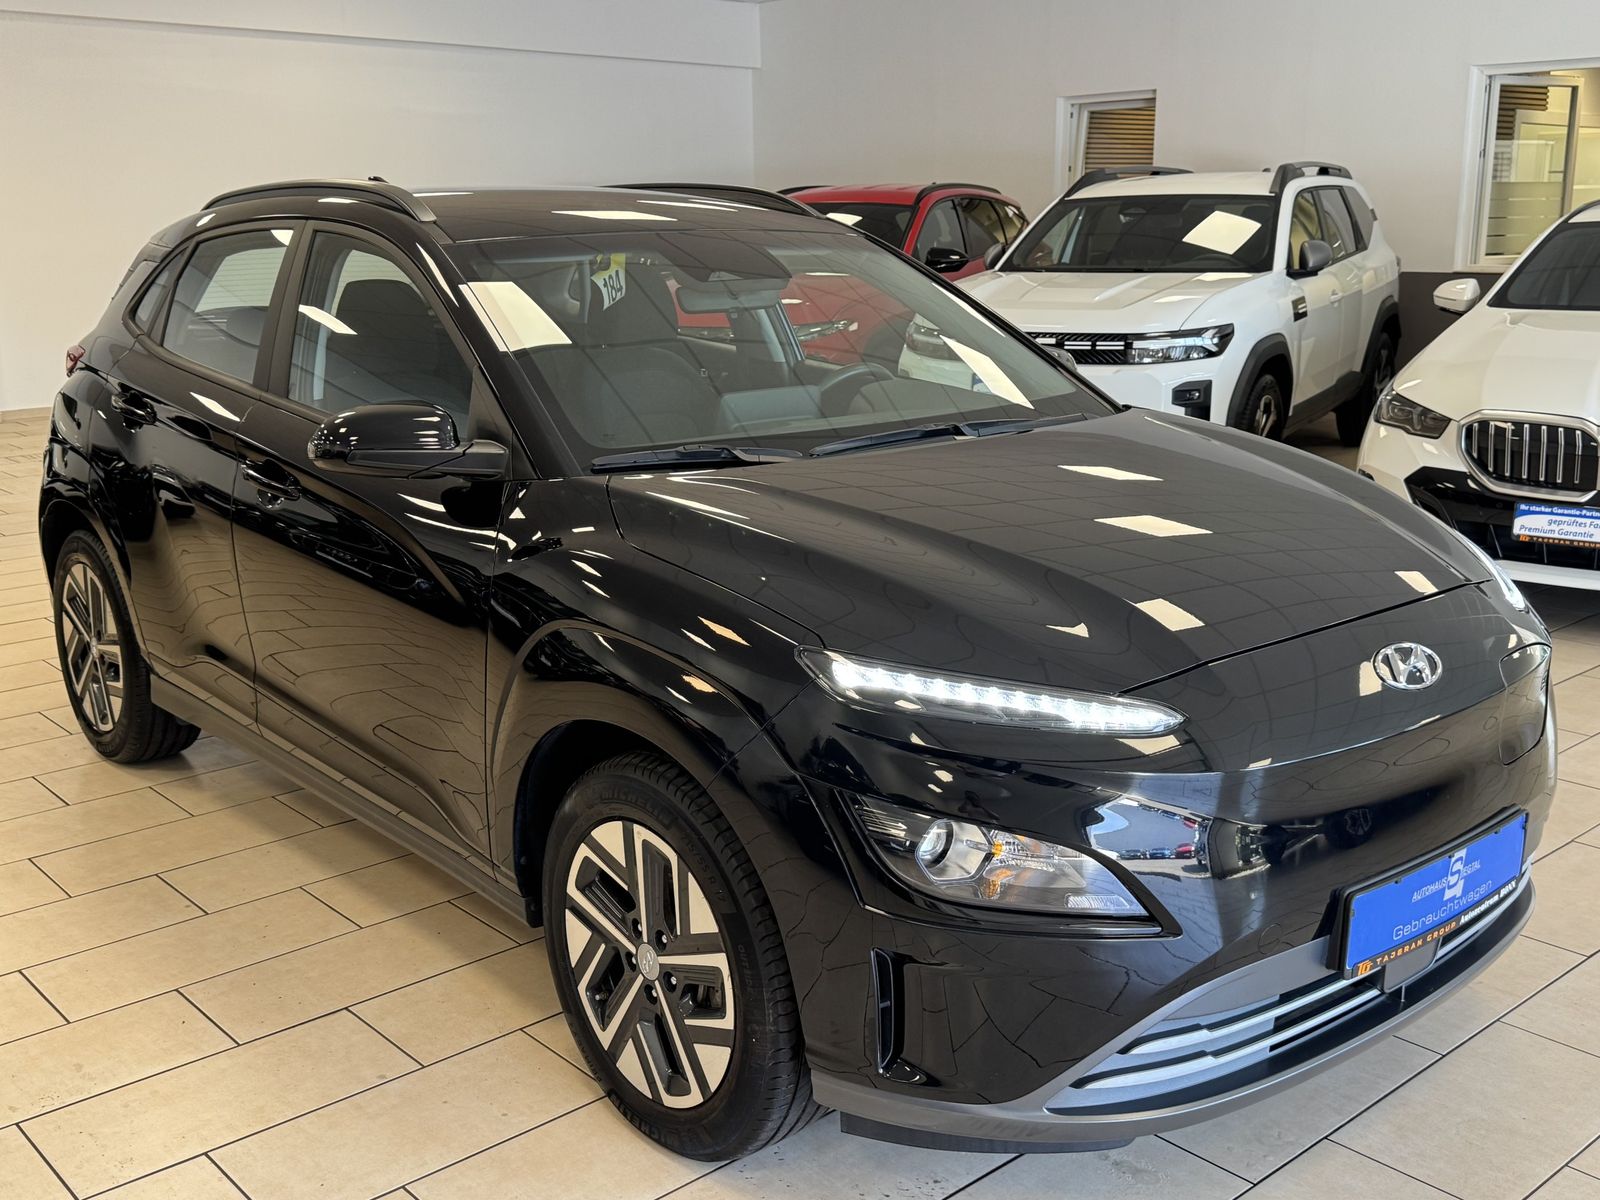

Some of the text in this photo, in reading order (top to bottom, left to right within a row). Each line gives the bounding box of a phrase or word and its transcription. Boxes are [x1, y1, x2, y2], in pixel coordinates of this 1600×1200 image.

[603, 269, 623, 304] 184
[1530, 505, 1552, 513] starker
[1519, 524, 1594, 539] Premium Garantie
[1547, 518, 1587, 529] geprüftes
[1411, 876, 1449, 903] AUTOHAUS
[1393, 880, 1492, 941] Gebrauchtwagen
[1426, 921, 1456, 942] GROUP
